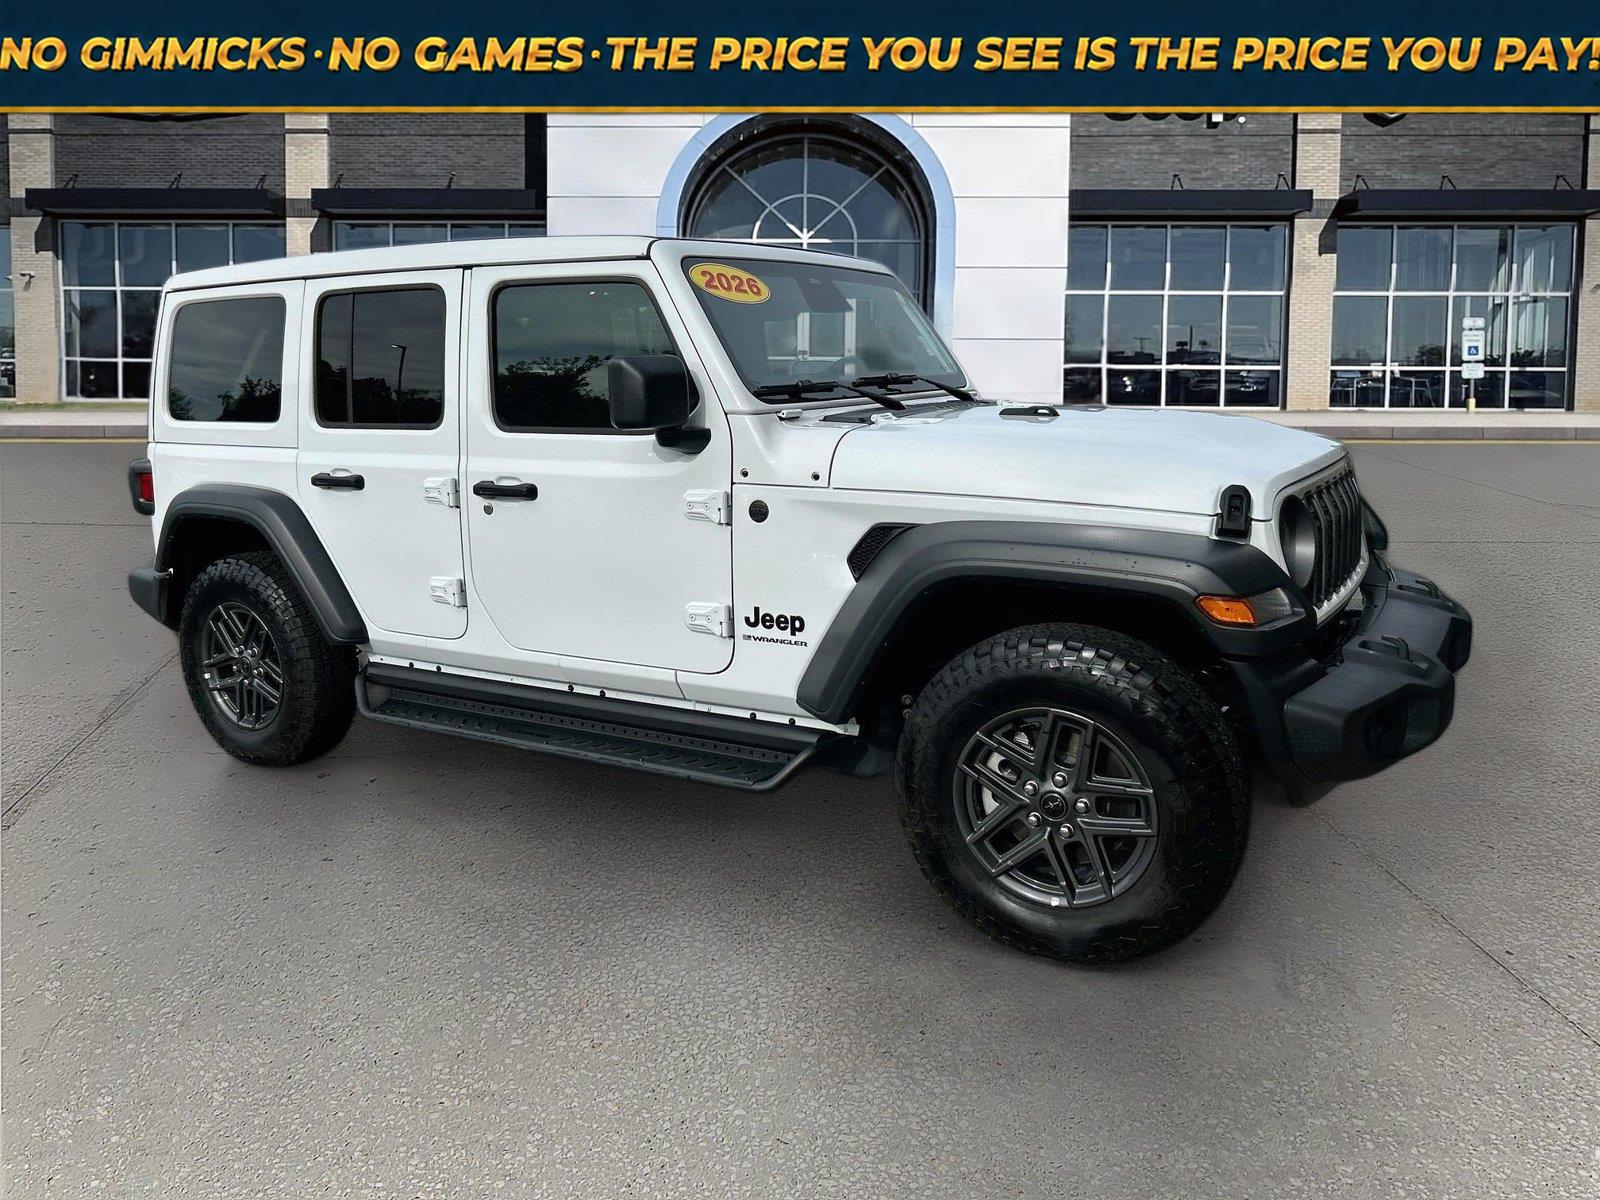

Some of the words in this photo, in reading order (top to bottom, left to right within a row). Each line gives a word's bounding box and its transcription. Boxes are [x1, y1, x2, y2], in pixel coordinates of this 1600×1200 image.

[700, 270, 762, 297] 2026
[744, 606, 805, 637] Jeep
[752, 635, 808, 647] WRANGLER
